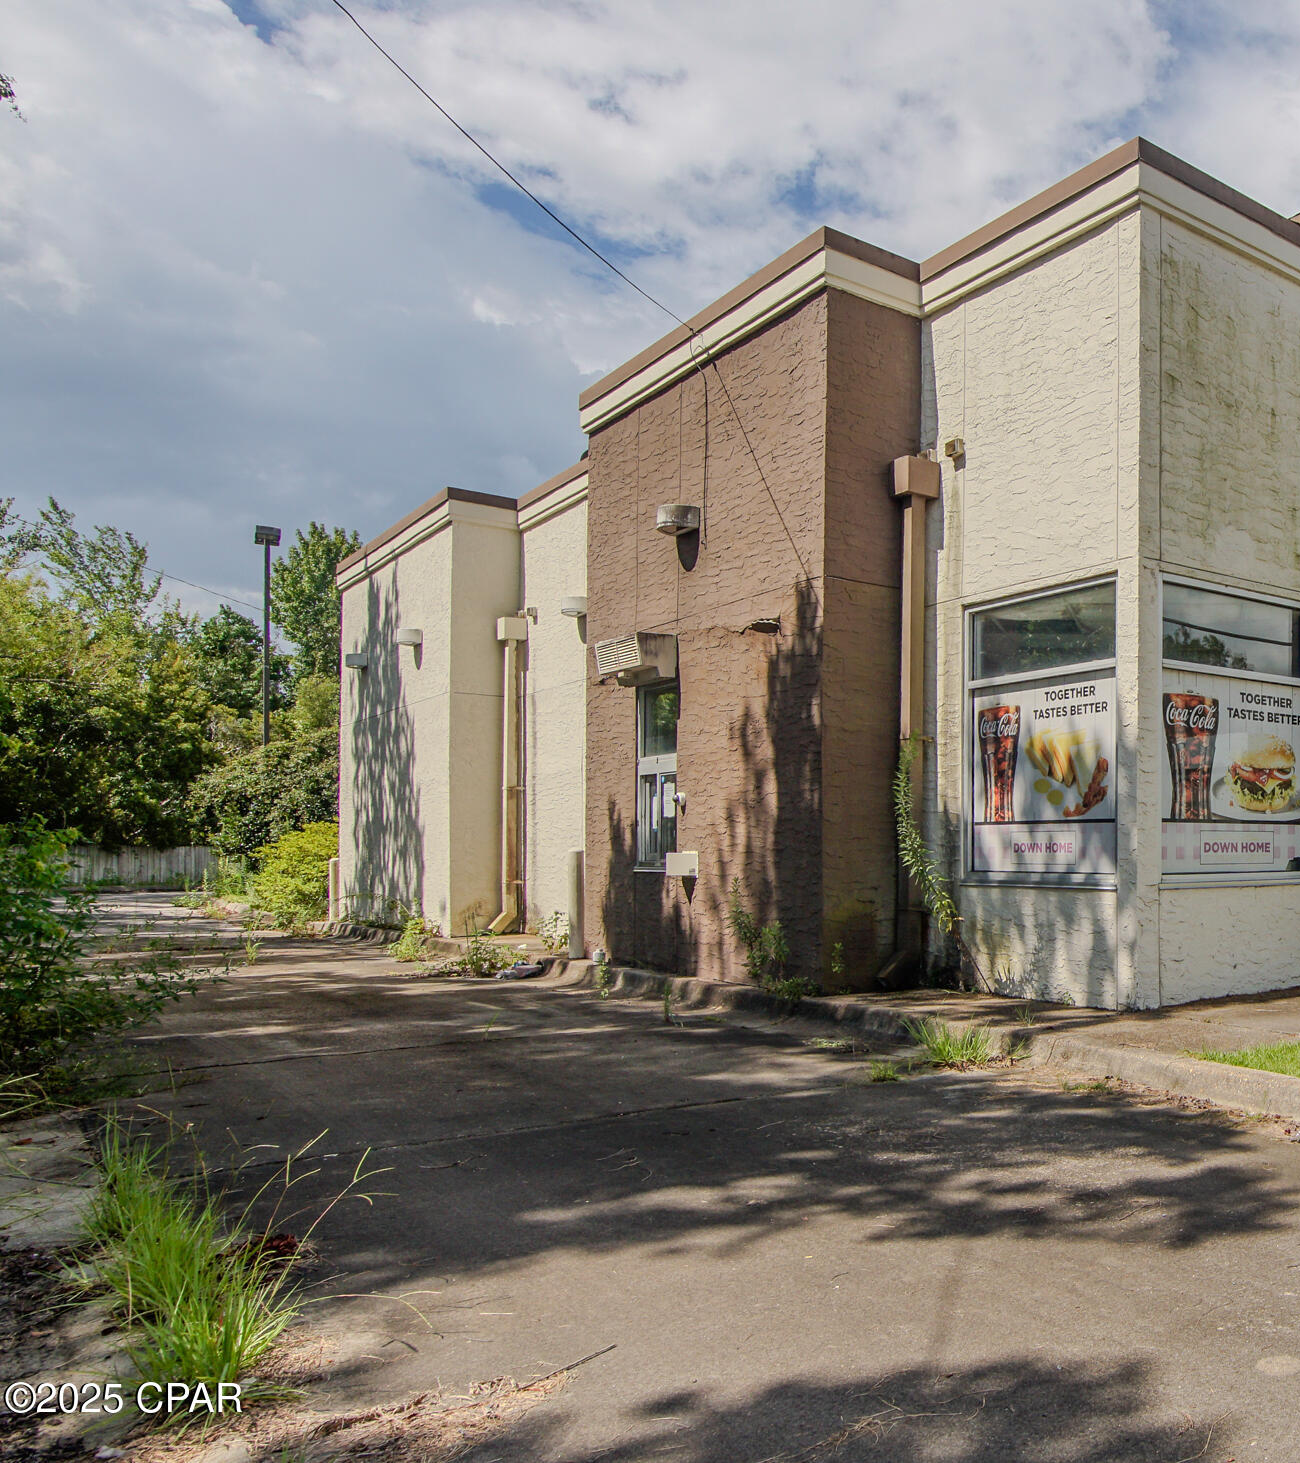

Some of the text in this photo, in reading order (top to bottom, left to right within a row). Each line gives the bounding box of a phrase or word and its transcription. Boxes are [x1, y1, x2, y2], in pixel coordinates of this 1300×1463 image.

[1044, 685, 1096, 702] TOGETHER
[1239, 691, 1293, 709] TOGETHER
[1033, 701, 1108, 720] TASTES BETTER
[1165, 701, 1218, 730] Coca-Cola
[1227, 707, 1265, 722] TASTES
[1013, 842, 1073, 853] DOWN HOME
[1203, 842, 1271, 853] DOWN HOME
